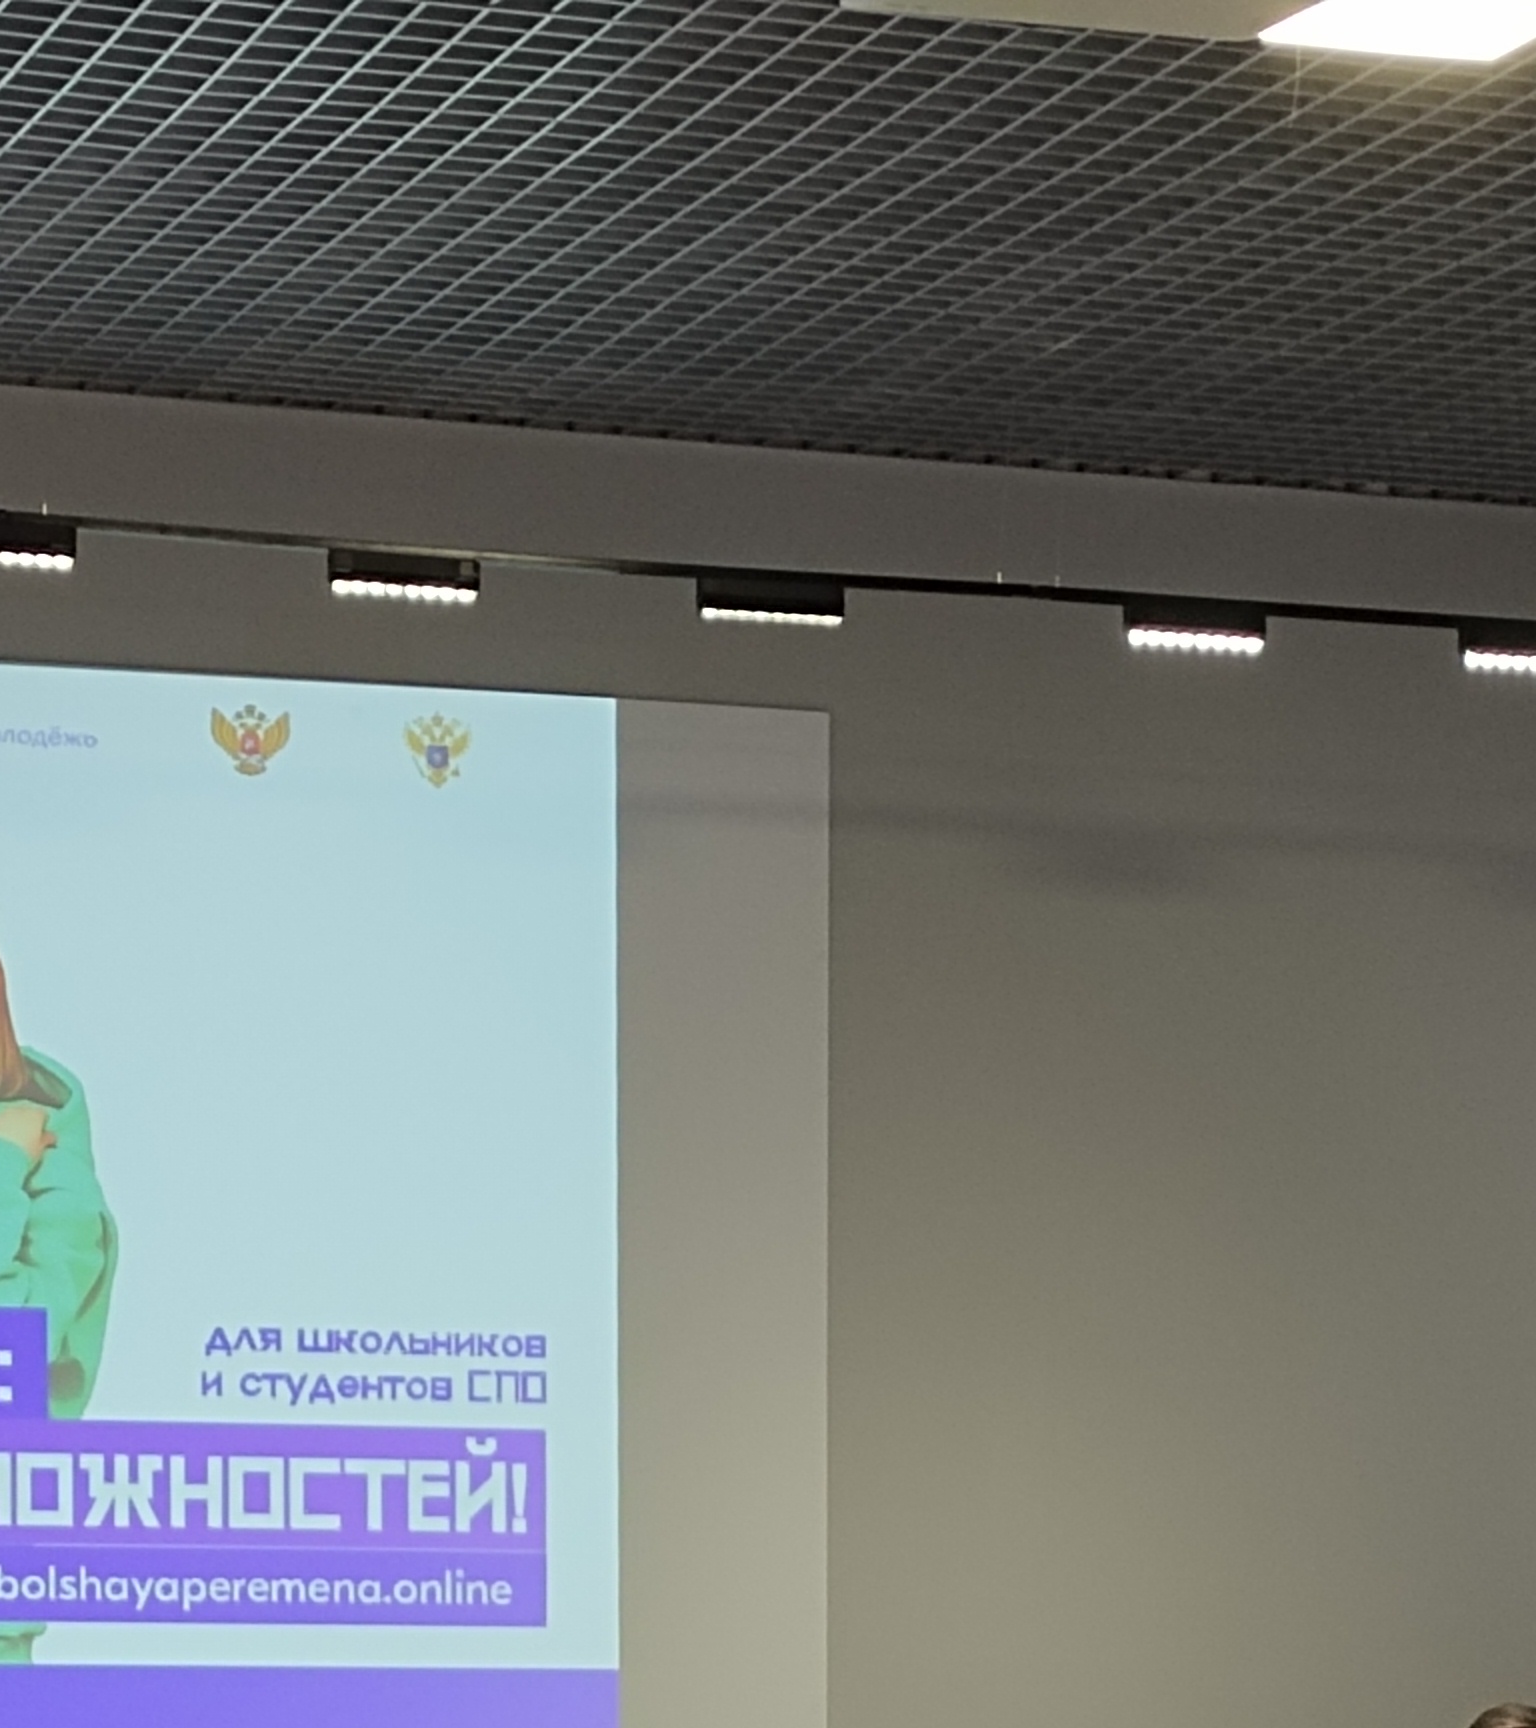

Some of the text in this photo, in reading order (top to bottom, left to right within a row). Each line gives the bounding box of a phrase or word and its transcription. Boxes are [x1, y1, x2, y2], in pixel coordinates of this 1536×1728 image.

[205, 1327, 547, 1359] для школьников
[201, 1371, 547, 1406] и студентов СПО
